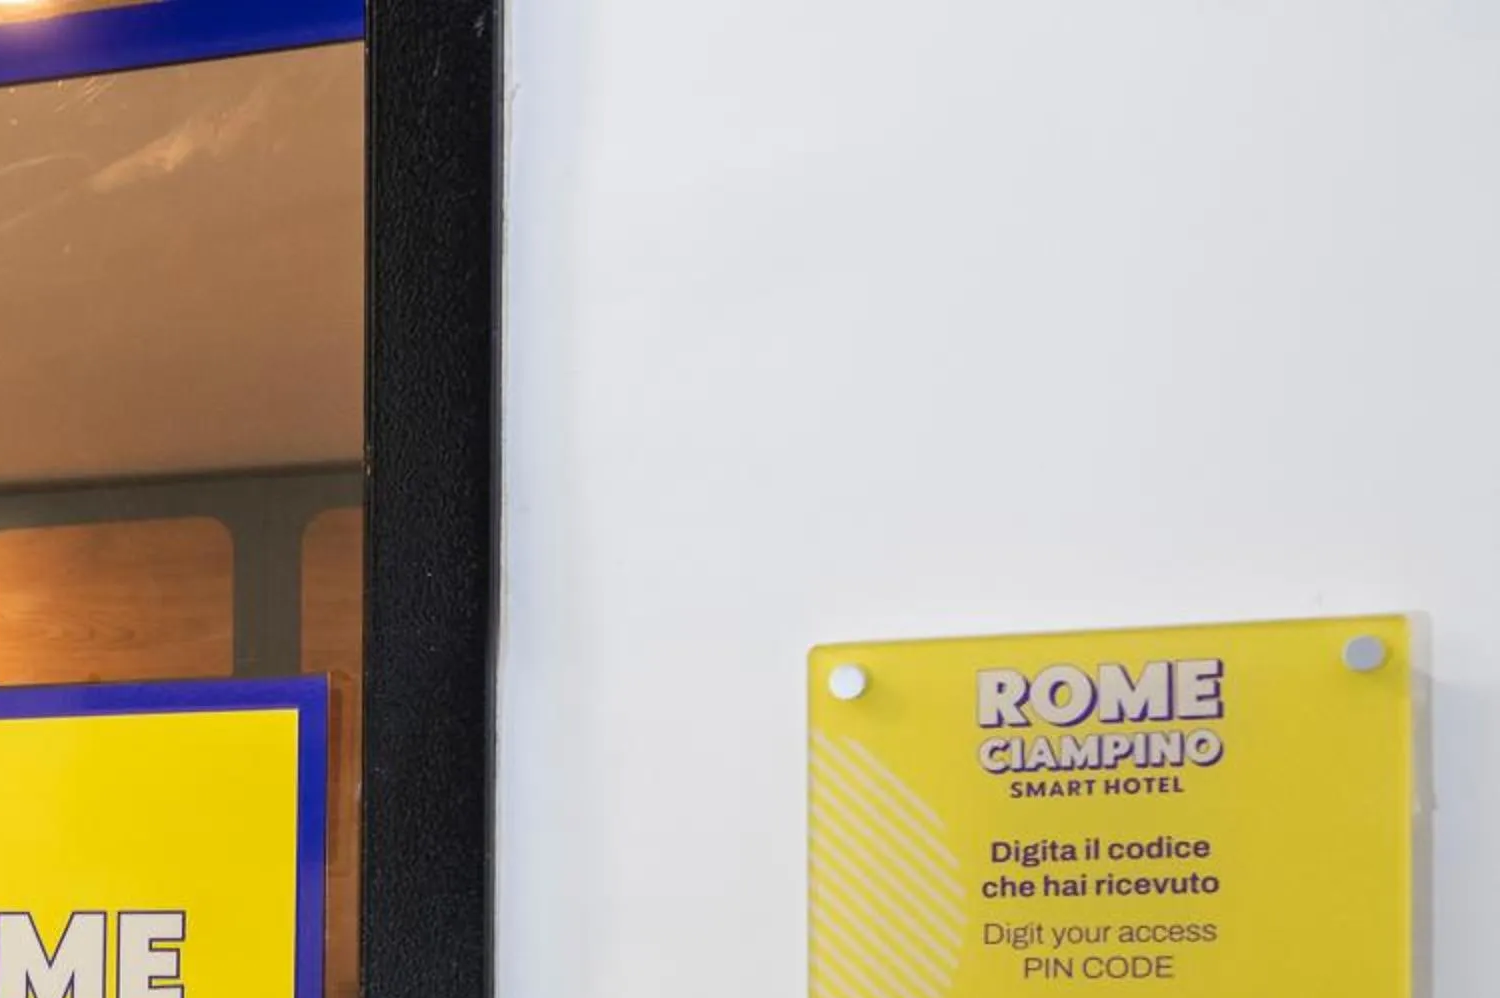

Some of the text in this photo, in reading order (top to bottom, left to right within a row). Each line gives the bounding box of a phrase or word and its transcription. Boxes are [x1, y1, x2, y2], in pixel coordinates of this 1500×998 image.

[977, 658, 1224, 728] ROME
[979, 731, 1223, 773] CIAMPINO
[1011, 776, 1184, 798] SMART HOTEL
[991, 836, 1211, 867] Digita il codice
[982, 873, 1219, 898] che hai ricevuto
[984, 922, 1218, 950] Digit your access
[1024, 955, 1173, 978] PIN CODE
